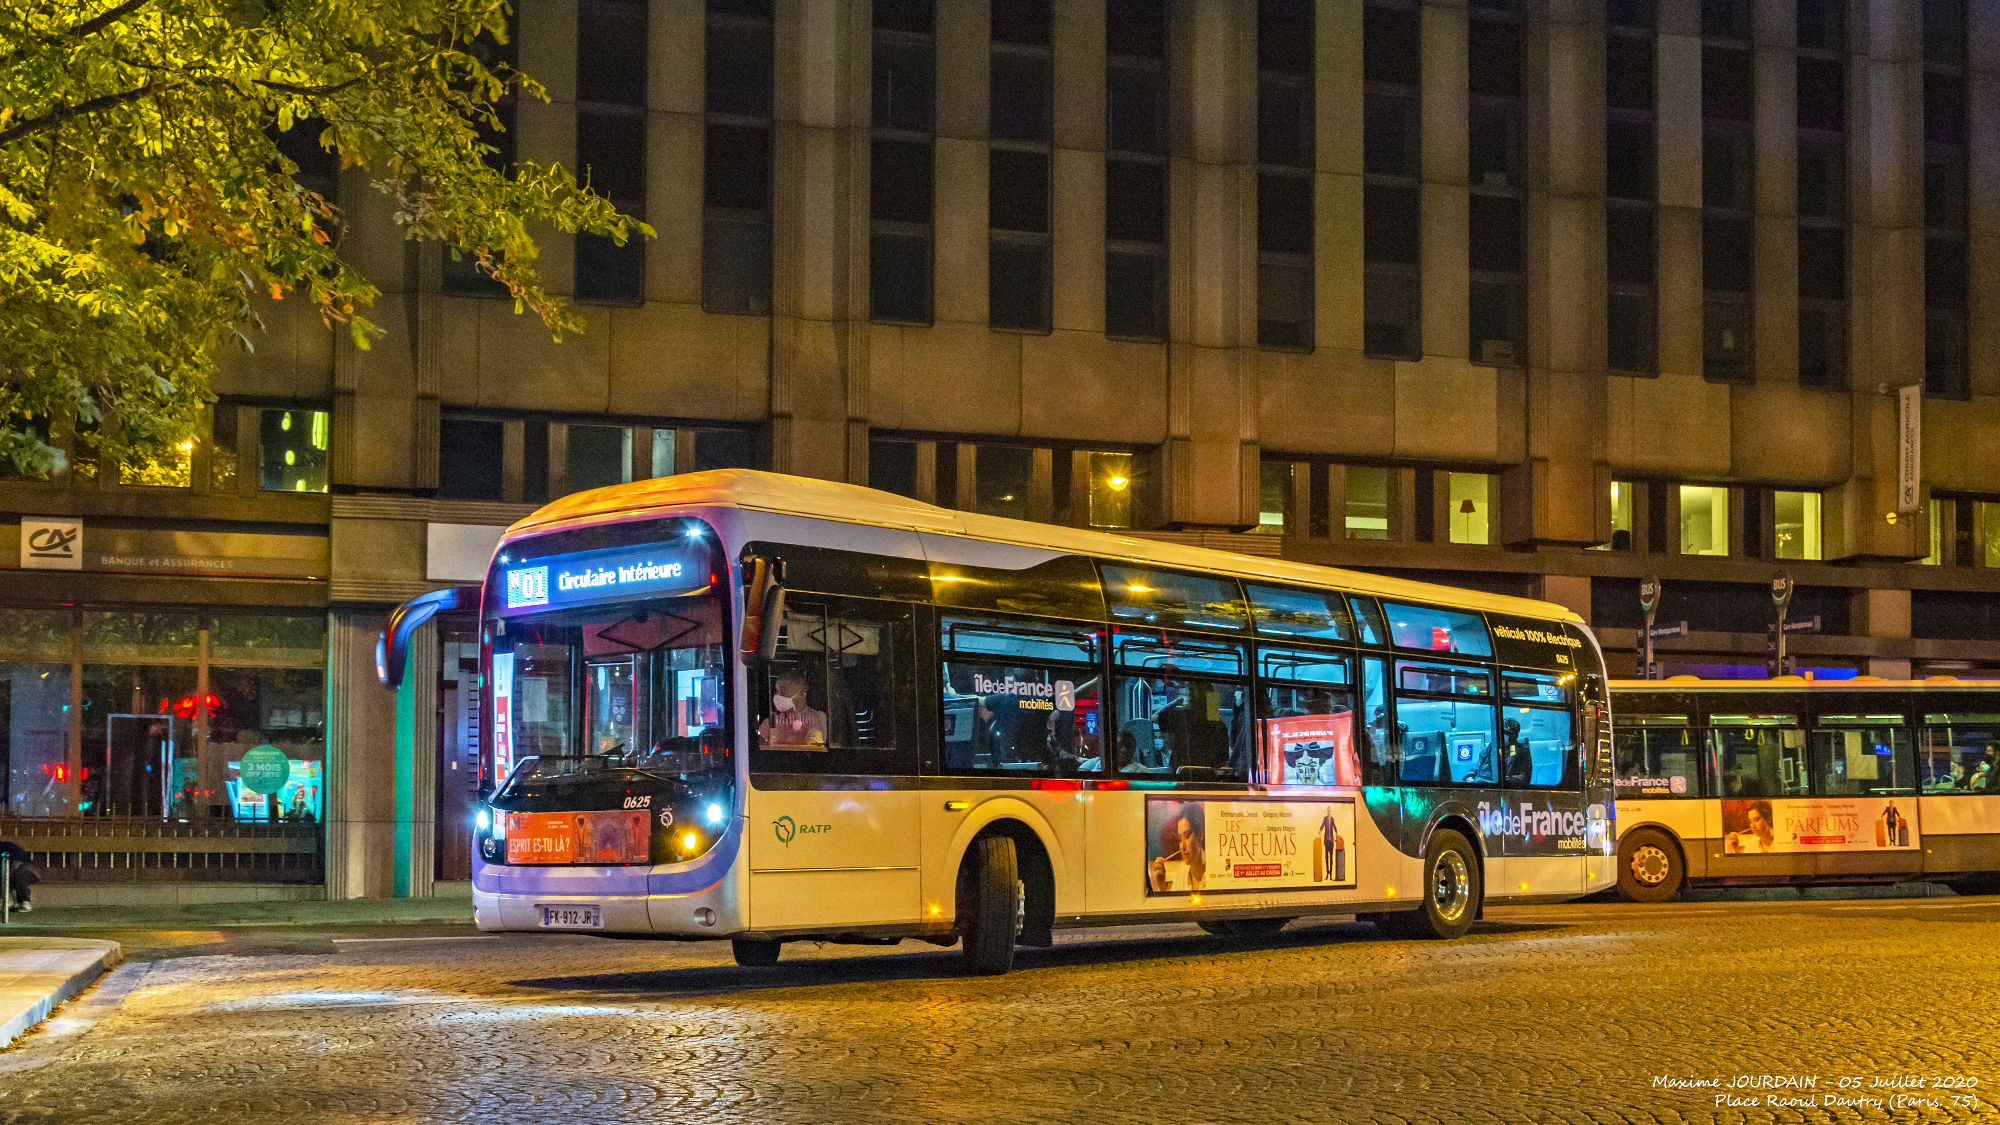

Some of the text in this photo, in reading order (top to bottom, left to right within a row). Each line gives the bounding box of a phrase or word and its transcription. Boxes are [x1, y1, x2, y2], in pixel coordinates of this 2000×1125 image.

[101, 556, 233, 569] BANQUE et ASSURANCES
[558, 561, 682, 590] Circulaire Intérieure
[1641, 583, 1654, 596] BUS
[1773, 578, 1786, 590] BUS
[1494, 625, 1582, 649] véhicule 100% électrique
[1555, 654, 1569, 665] 0625
[1019, 698, 1054, 711] mobilités
[247, 763, 282, 771] 3 MOIS
[623, 795, 651, 809] 0625
[799, 824, 832, 833] RATP
[1225, 820, 1241, 832] LES
[1282, 825, 1296, 833] Magne
[1786, 817, 1859, 834] PARFUMS
[510, 838, 531, 854] ESPRIT
[533, 837, 553, 852] ES-TU
[1219, 832, 1297, 861] PARFUMS
[1557, 836, 1586, 850] mobilités
[549, 910, 592, 924] FK-912-JR
